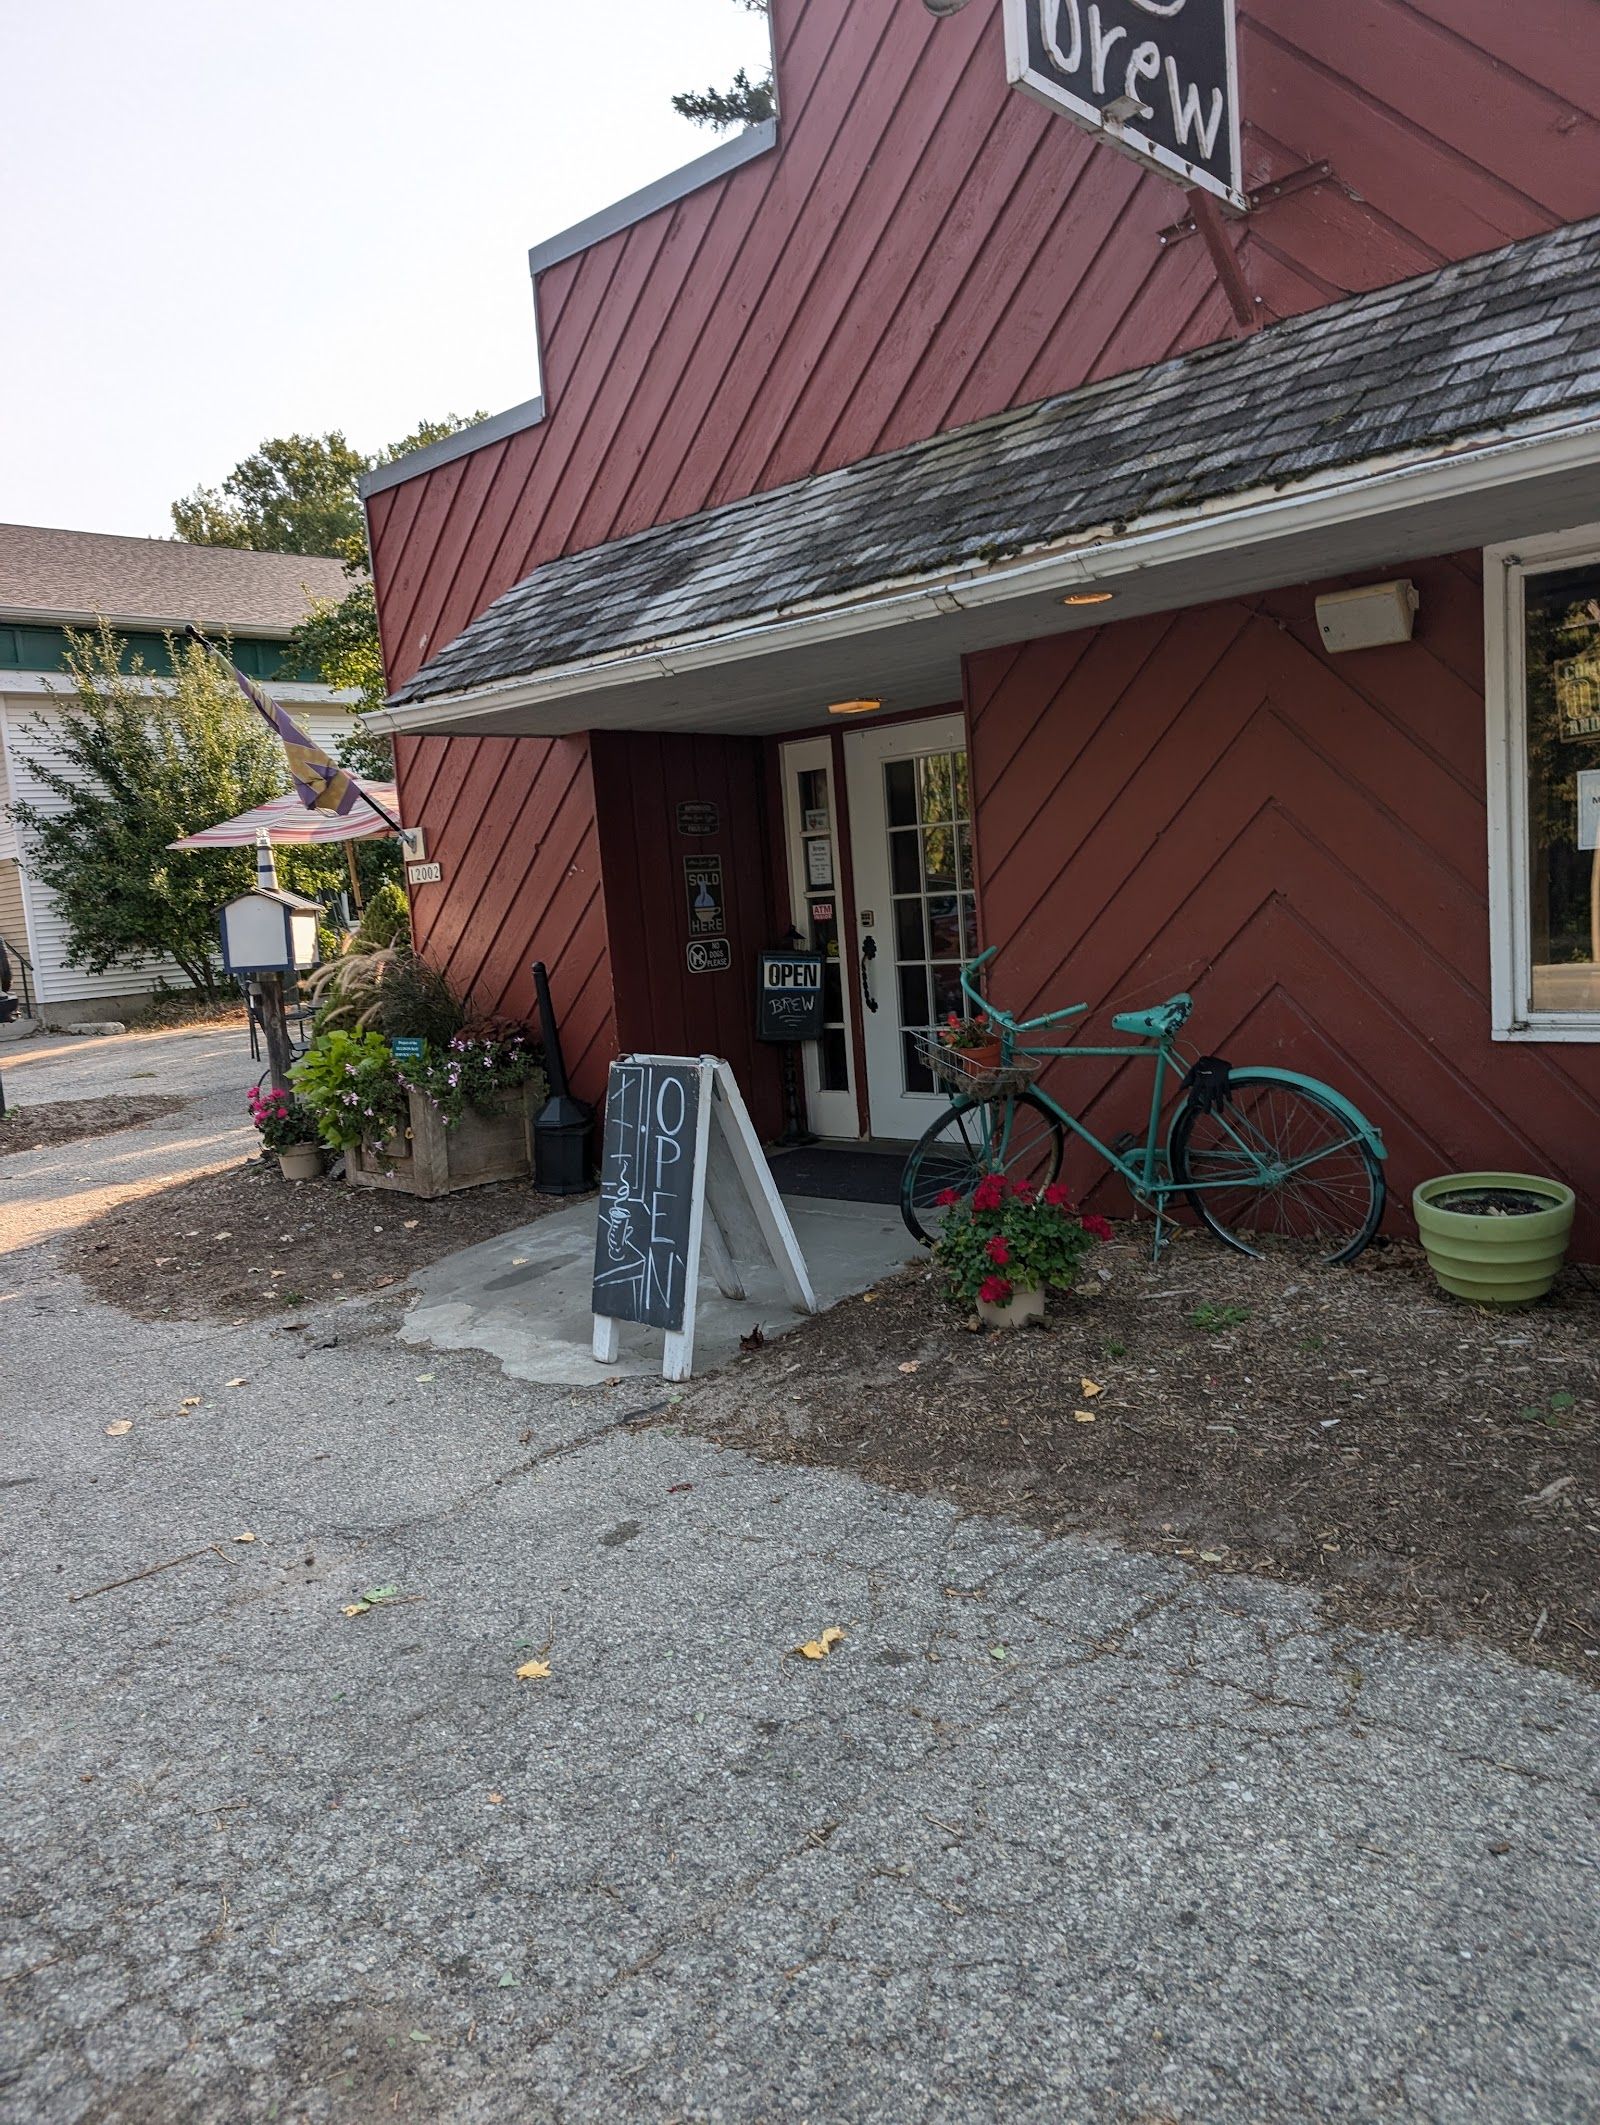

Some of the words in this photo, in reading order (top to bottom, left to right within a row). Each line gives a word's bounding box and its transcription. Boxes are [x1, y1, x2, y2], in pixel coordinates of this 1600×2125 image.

[410, 865, 439, 882] 12002
[689, 873, 719, 886] SOLD
[814, 905, 832, 914] ATM
[692, 919, 722, 932] HERE
[711, 942, 720, 950] NO
[709, 950, 724, 959] DOGS
[707, 957, 728, 967] PLEASE
[768, 963, 817, 987] OPEN
[768, 995, 815, 1016] BREW
[646, 1076, 684, 1310] OPEN
